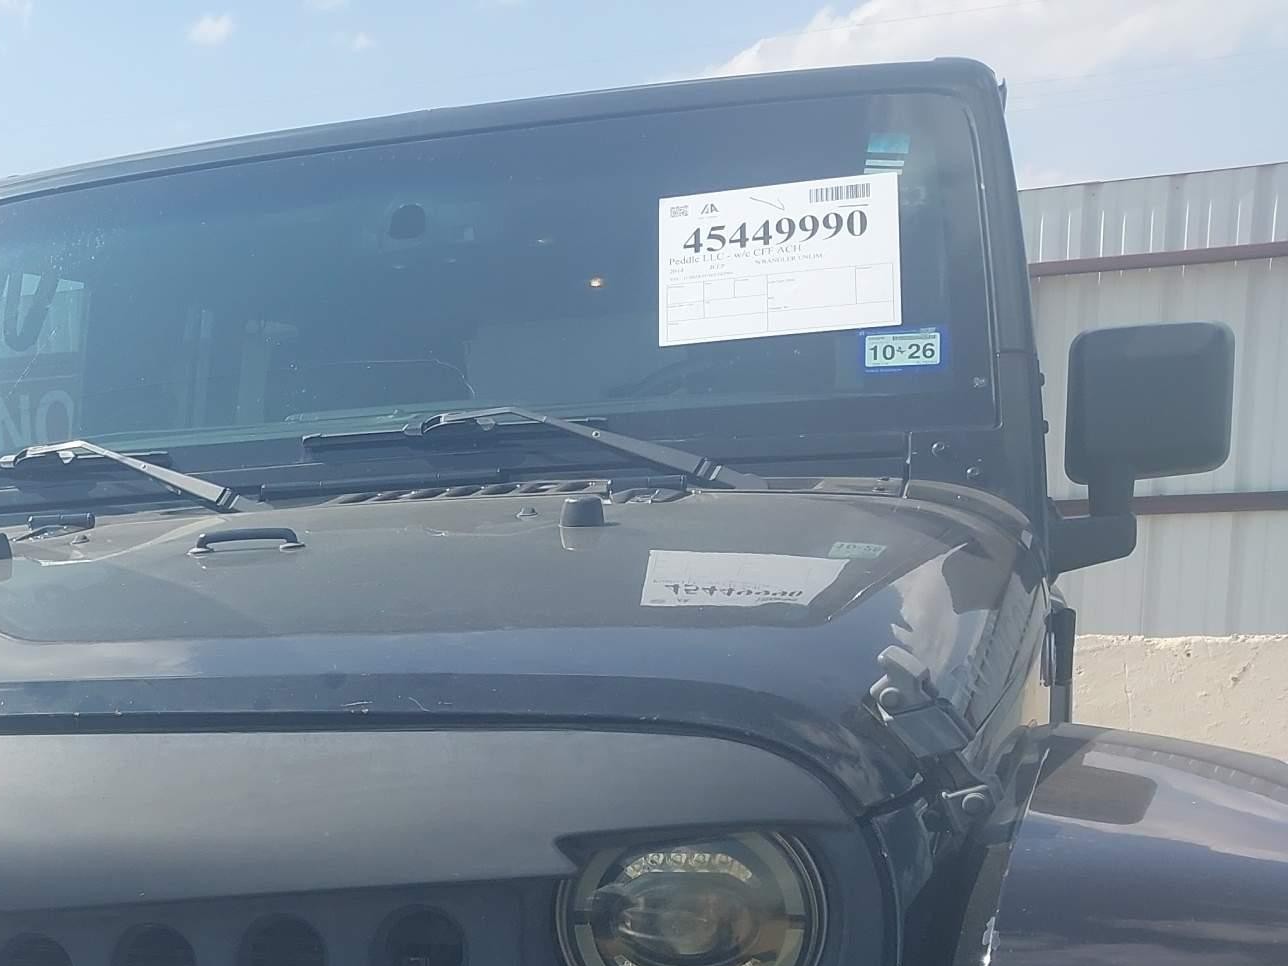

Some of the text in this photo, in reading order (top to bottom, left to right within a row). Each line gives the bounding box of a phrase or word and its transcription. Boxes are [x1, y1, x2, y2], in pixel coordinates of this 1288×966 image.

[683, 209, 868, 253] 45449990
[669, 255, 700, 266] Peddle
[908, 342, 935, 360] 26
